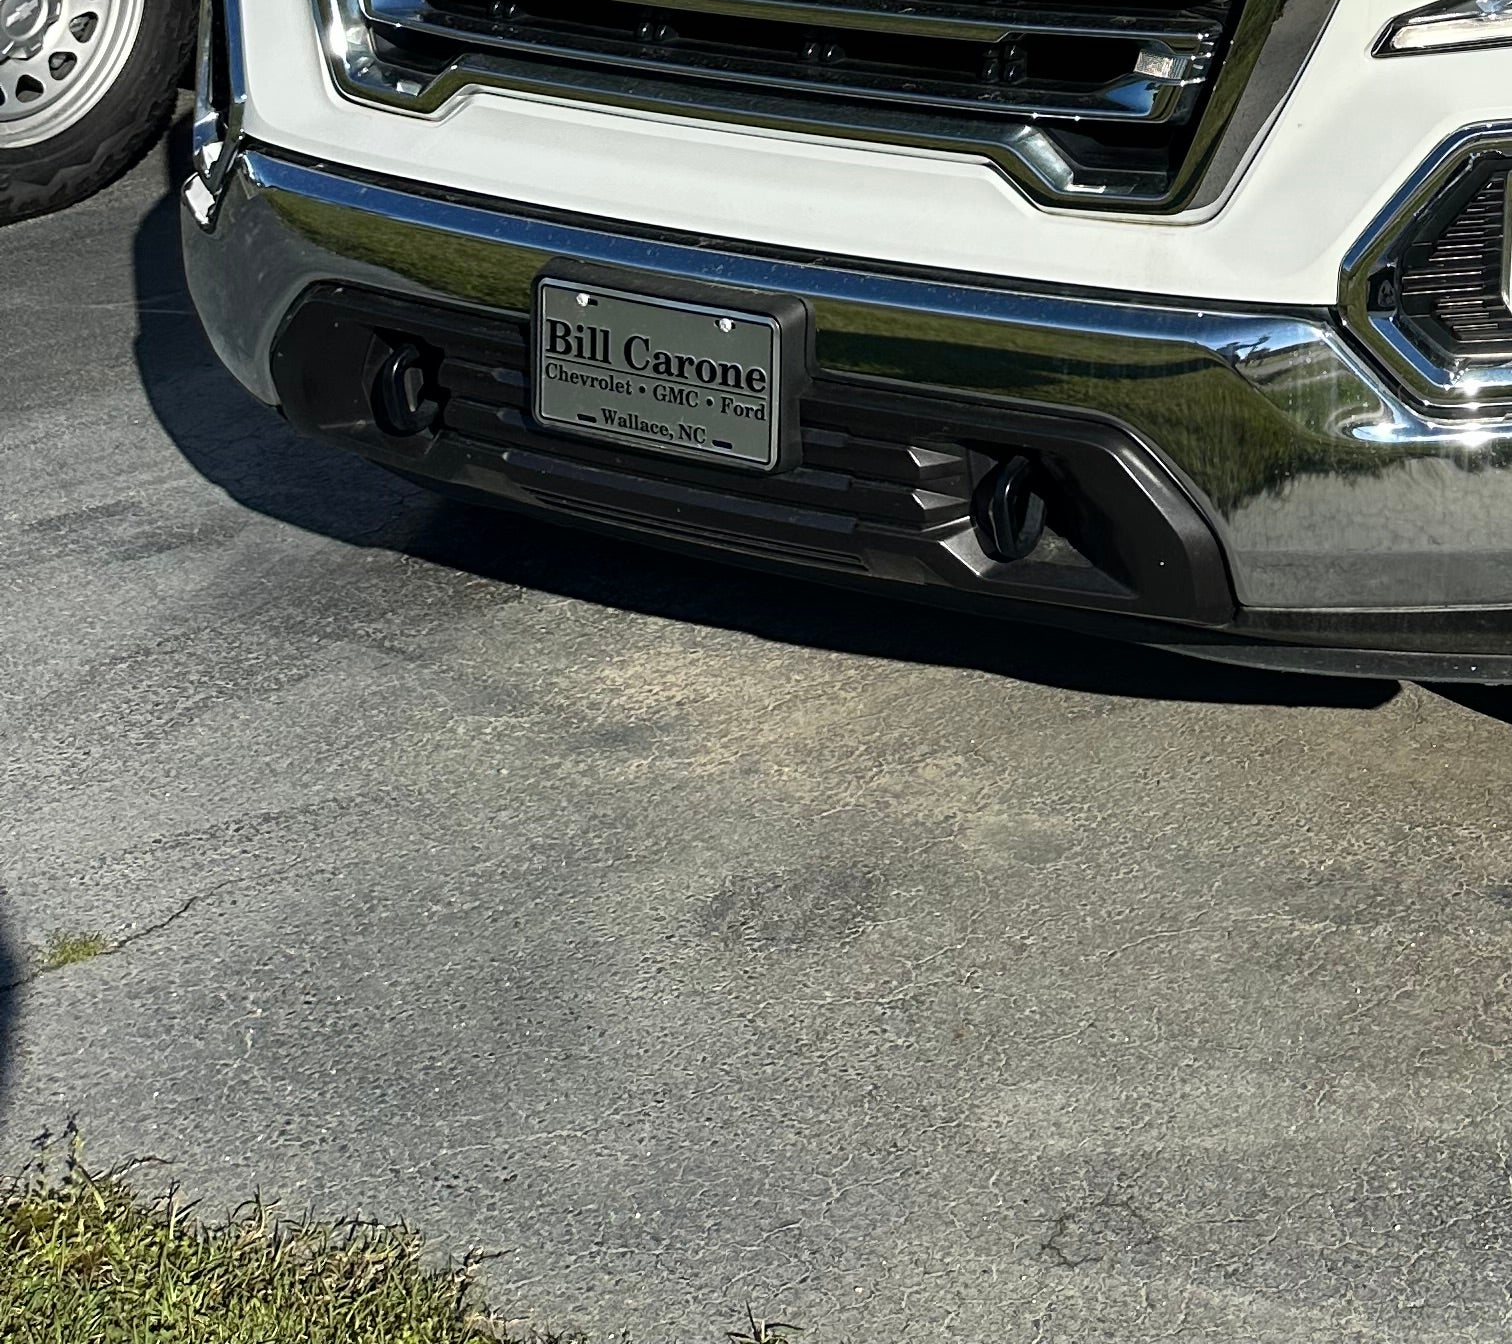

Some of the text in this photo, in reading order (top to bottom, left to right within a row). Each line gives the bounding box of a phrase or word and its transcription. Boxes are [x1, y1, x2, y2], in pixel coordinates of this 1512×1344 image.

[546, 318, 766, 393] Bill Carone
[545, 362, 766, 421] Chevrolet GMC Ford
[600, 408, 706, 444] Wallace, NC
